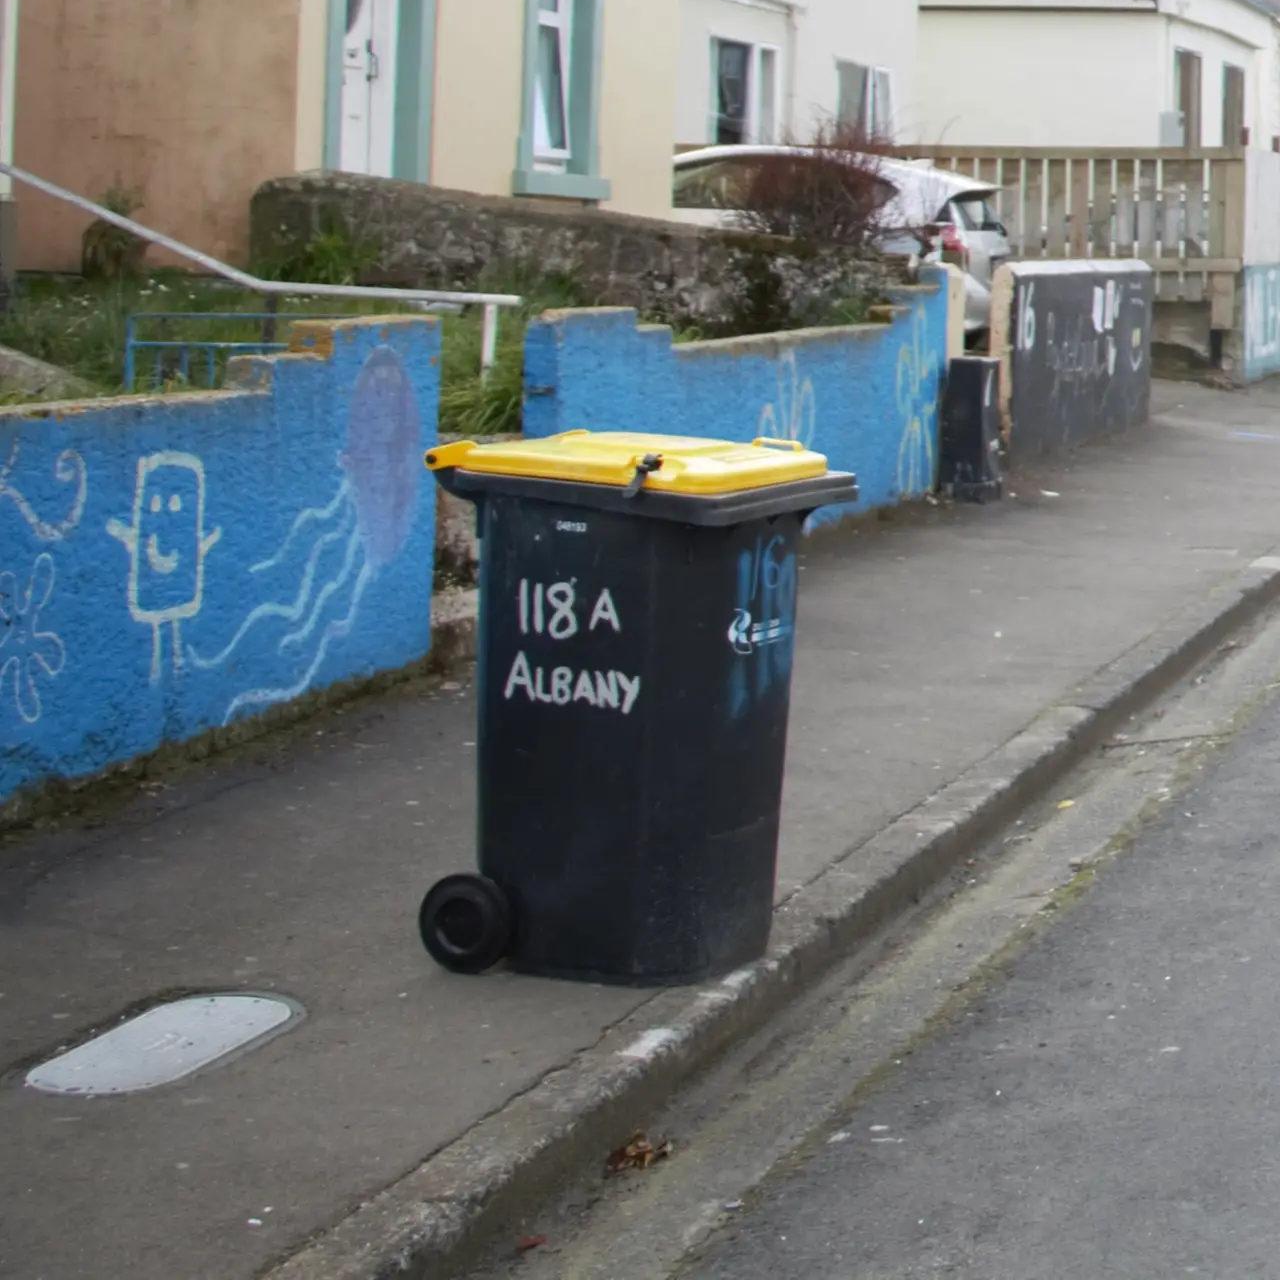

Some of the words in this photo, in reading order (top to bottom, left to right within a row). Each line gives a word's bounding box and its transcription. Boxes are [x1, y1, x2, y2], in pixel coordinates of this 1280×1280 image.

[1017, 281, 1036, 350] 16
[517, 577, 579, 640] 118
[588, 587, 621, 632] A
[504, 650, 641, 715] ALBANY
